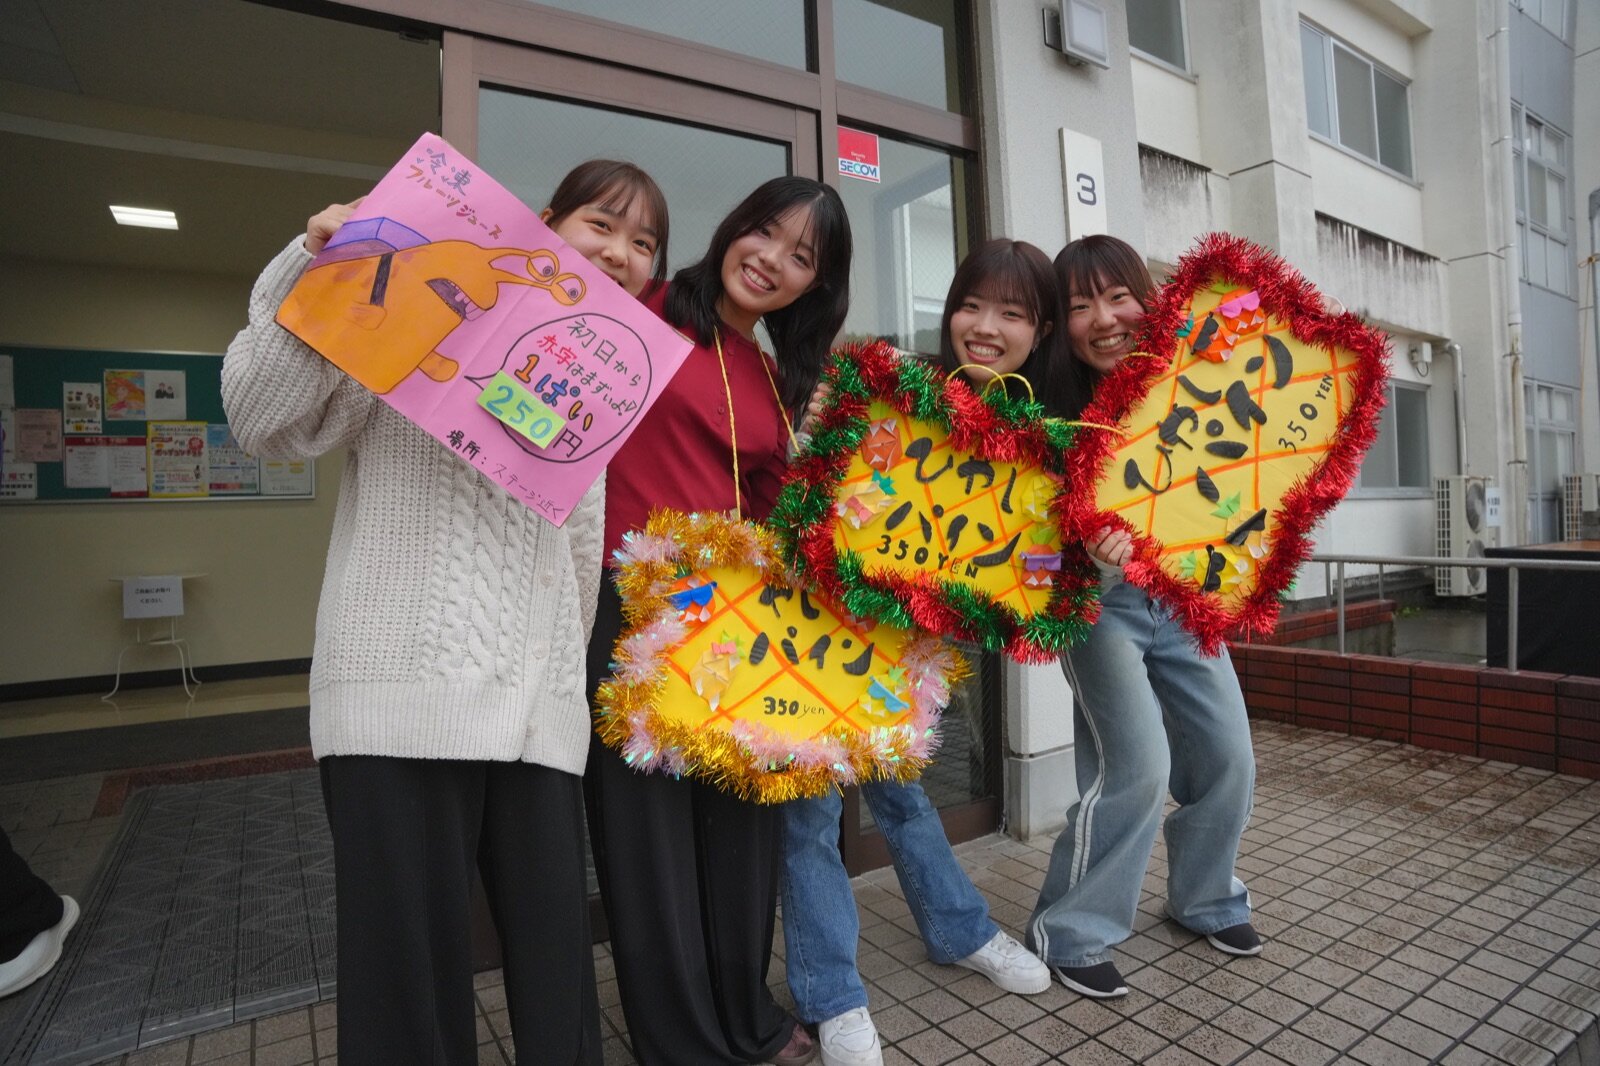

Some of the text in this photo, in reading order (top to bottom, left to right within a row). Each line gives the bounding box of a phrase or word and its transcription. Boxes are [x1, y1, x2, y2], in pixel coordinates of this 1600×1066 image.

[416, 148, 472, 196] 冷凍
[840, 160, 877, 178] SECOM
[1076, 173, 1097, 206] 3
[406, 164, 502, 240] フルーツジュース
[567, 317, 641, 387] 初日から
[885, 501, 1022, 567] パイン
[749, 625, 875, 676] パイン
